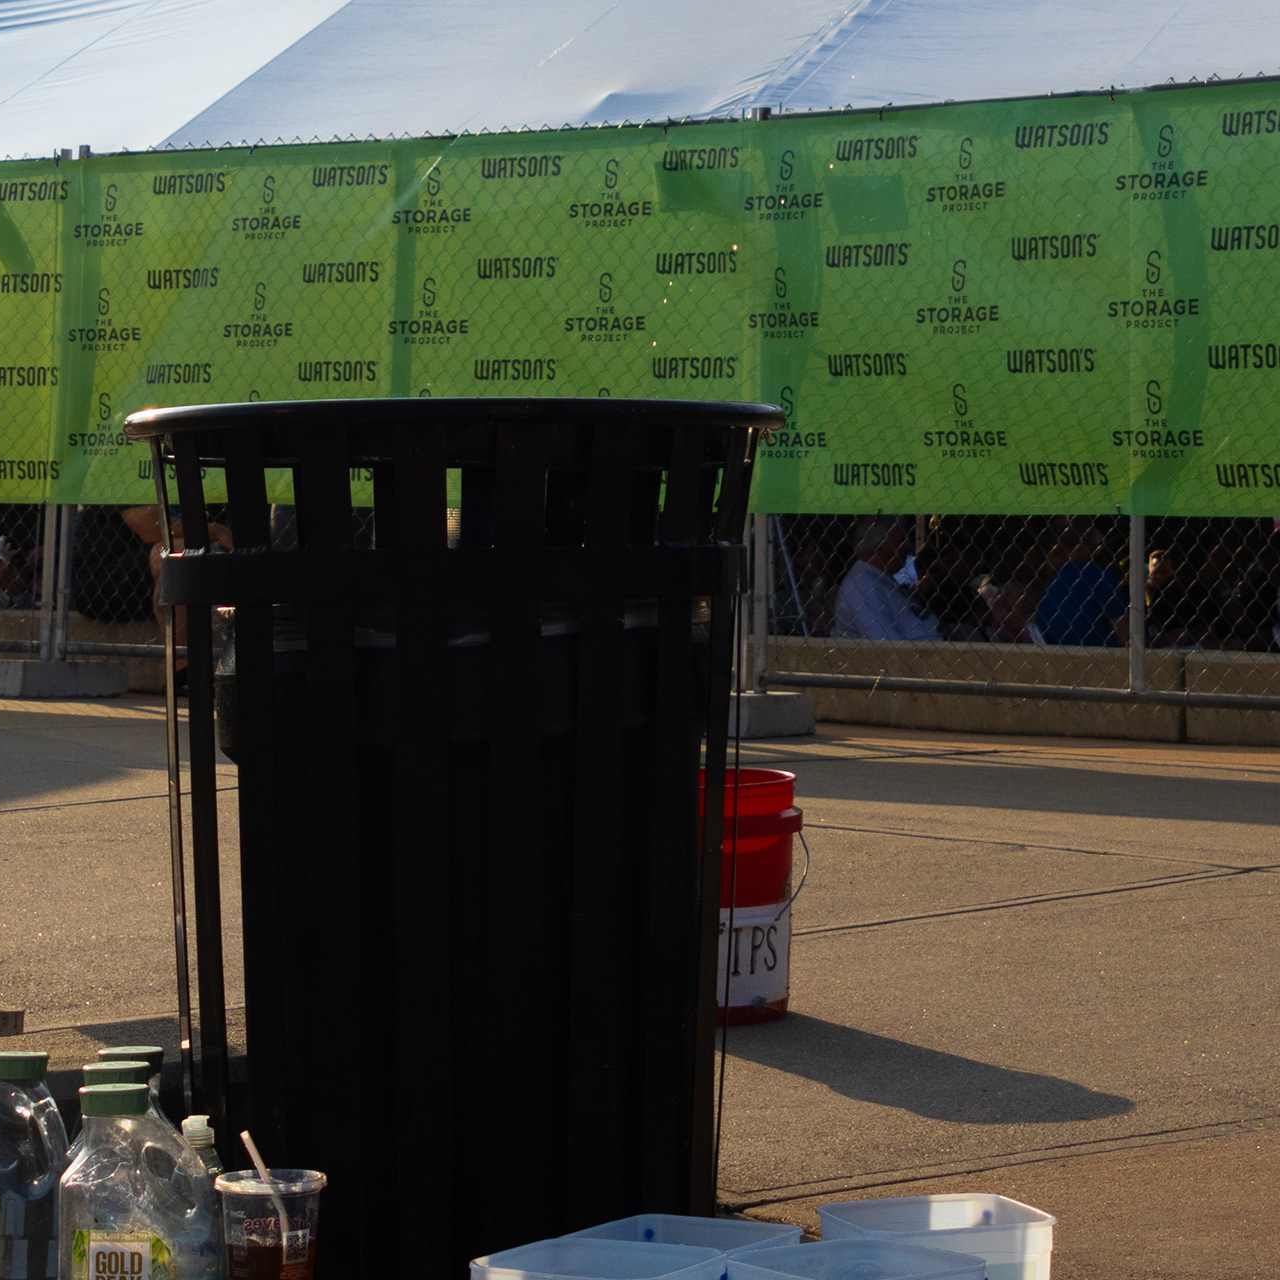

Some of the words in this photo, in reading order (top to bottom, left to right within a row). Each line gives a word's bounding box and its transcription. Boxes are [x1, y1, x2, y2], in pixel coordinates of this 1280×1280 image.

[1016, 123, 1108, 148] WATSON'S
[836, 136, 917, 161] WATSON'S
[482, 156, 561, 179] WATSON'S
[663, 147, 738, 172] WATSON'S
[154, 173, 225, 195] WATSON'S
[313, 165, 388, 187] WATSON'S
[1116, 171, 1208, 191] STORAGE
[745, 193, 822, 210] STORAGE
[927, 182, 1004, 202] STORAGE
[393, 209, 470, 224] STORAGE
[570, 202, 651, 218] STORAGE
[943, 202, 987, 211] PROJECT
[74, 223, 141, 238] STORAGE
[233, 216, 300, 231] STORAGE
[408, 226, 454, 234] PROJECT
[586, 219, 632, 227] PROJECT
[826, 243, 908, 267] WATSON'S
[1012, 234, 1096, 260] WATSON'S
[303, 262, 378, 283] WATSON'S
[478, 257, 555, 279] WATSON'S
[657, 251, 736, 274] WATSON'S
[148, 268, 218, 289] WATSON'S
[917, 306, 998, 323] STORAGE
[1109, 299, 1198, 317] STORAGE
[224, 323, 292, 337] STORAGE
[390, 320, 467, 334] STORAGE
[566, 316, 645, 331] STORAGE
[751, 312, 818, 328] STORAGE
[69, 328, 140, 342] STORAGE
[299, 361, 375, 381] WATSON'S
[475, 359, 555, 380] WATSON'S
[653, 357, 735, 379] WATSON'S
[829, 354, 906, 376] WATSON'S
[1008, 349, 1094, 373] WATSON'S
[147, 363, 211, 384] WATSON'S
[1146, 419, 1167, 427] THE
[925, 431, 1007, 446] STORAGE
[1113, 430, 1203, 446] STORAGE
[1132, 449, 1184, 458] PROJECT
[835, 464, 915, 486] WATSON'S
[1020, 463, 1108, 486] WATSON'S
[719, 922, 778, 977] IPS
[95, 1250, 143, 1274] GOLD
